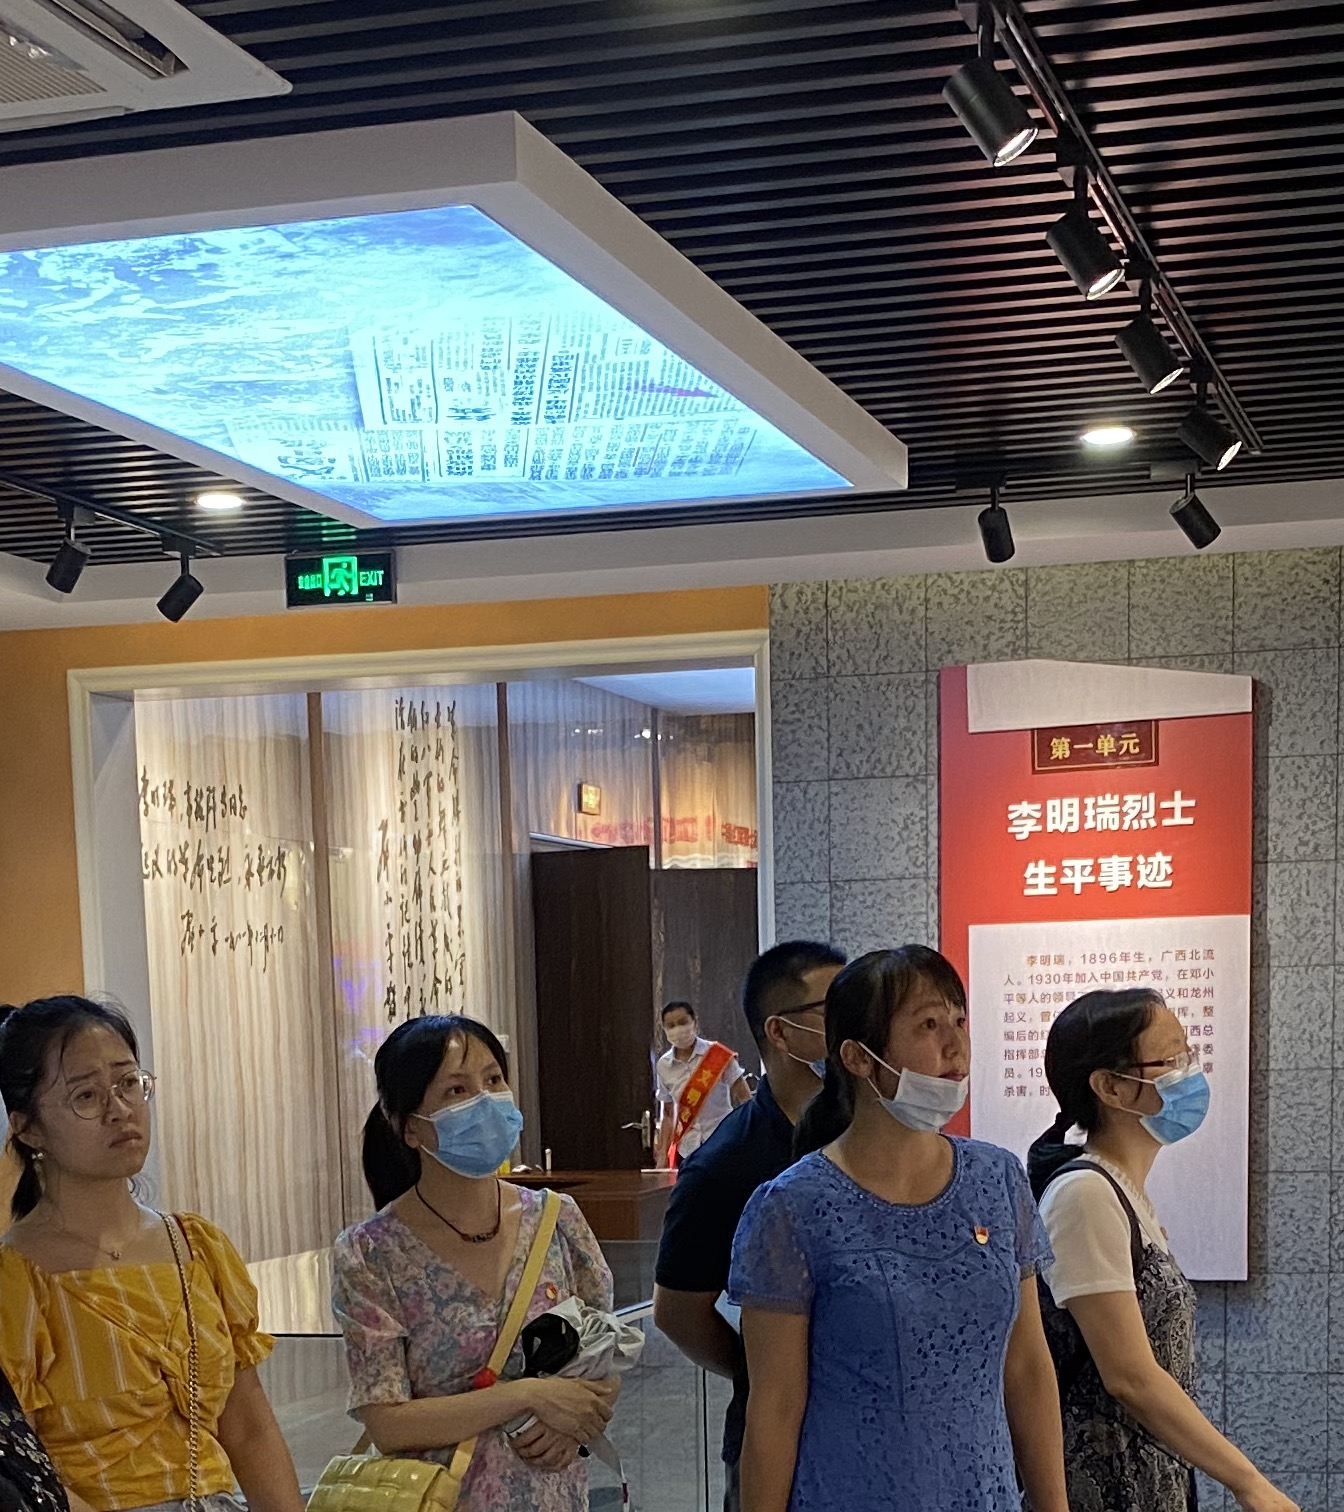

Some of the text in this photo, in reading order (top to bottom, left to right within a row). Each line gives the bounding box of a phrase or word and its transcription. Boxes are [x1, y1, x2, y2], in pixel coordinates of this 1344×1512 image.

[359, 569, 385, 587] EXIT
[1049, 733, 1142, 761] 第一单元
[1006, 789, 1197, 842] 李明瑞烈士
[1022, 851, 1174, 898] 生平事迹
[1003, 1010, 1056, 1024] 起义，曾
